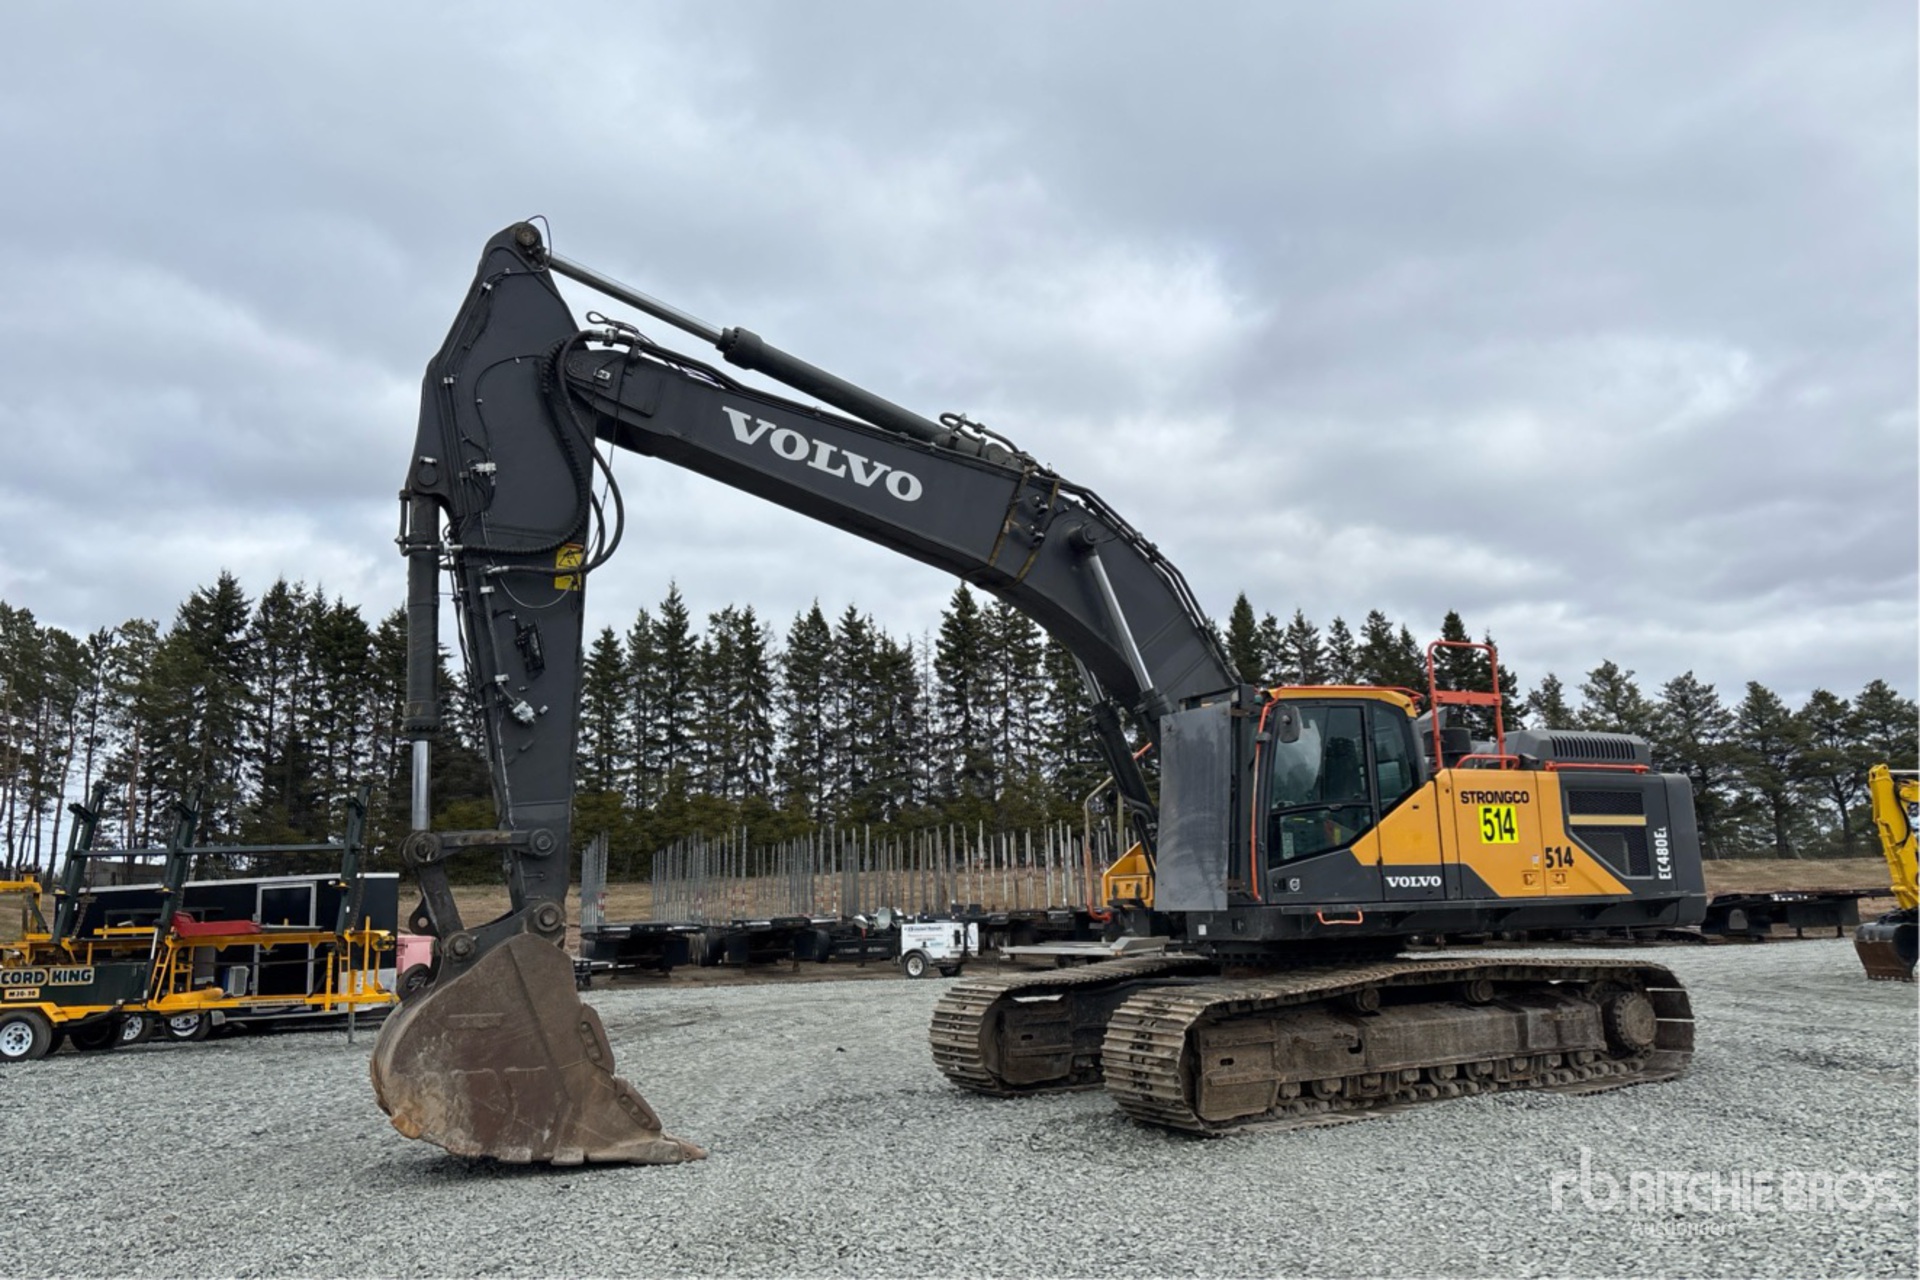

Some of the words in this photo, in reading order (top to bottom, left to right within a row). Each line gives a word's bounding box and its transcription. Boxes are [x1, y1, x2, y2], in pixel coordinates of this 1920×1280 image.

[722, 406, 923, 502] VOLVO
[1460, 790, 1530, 804] STRONGCO
[1482, 807, 1516, 842] 514
[1544, 846, 1575, 869] 514
[1386, 875, 1442, 888] VOLVO
[1, 971, 46, 985] CORD
[52, 969, 92, 983] KING
